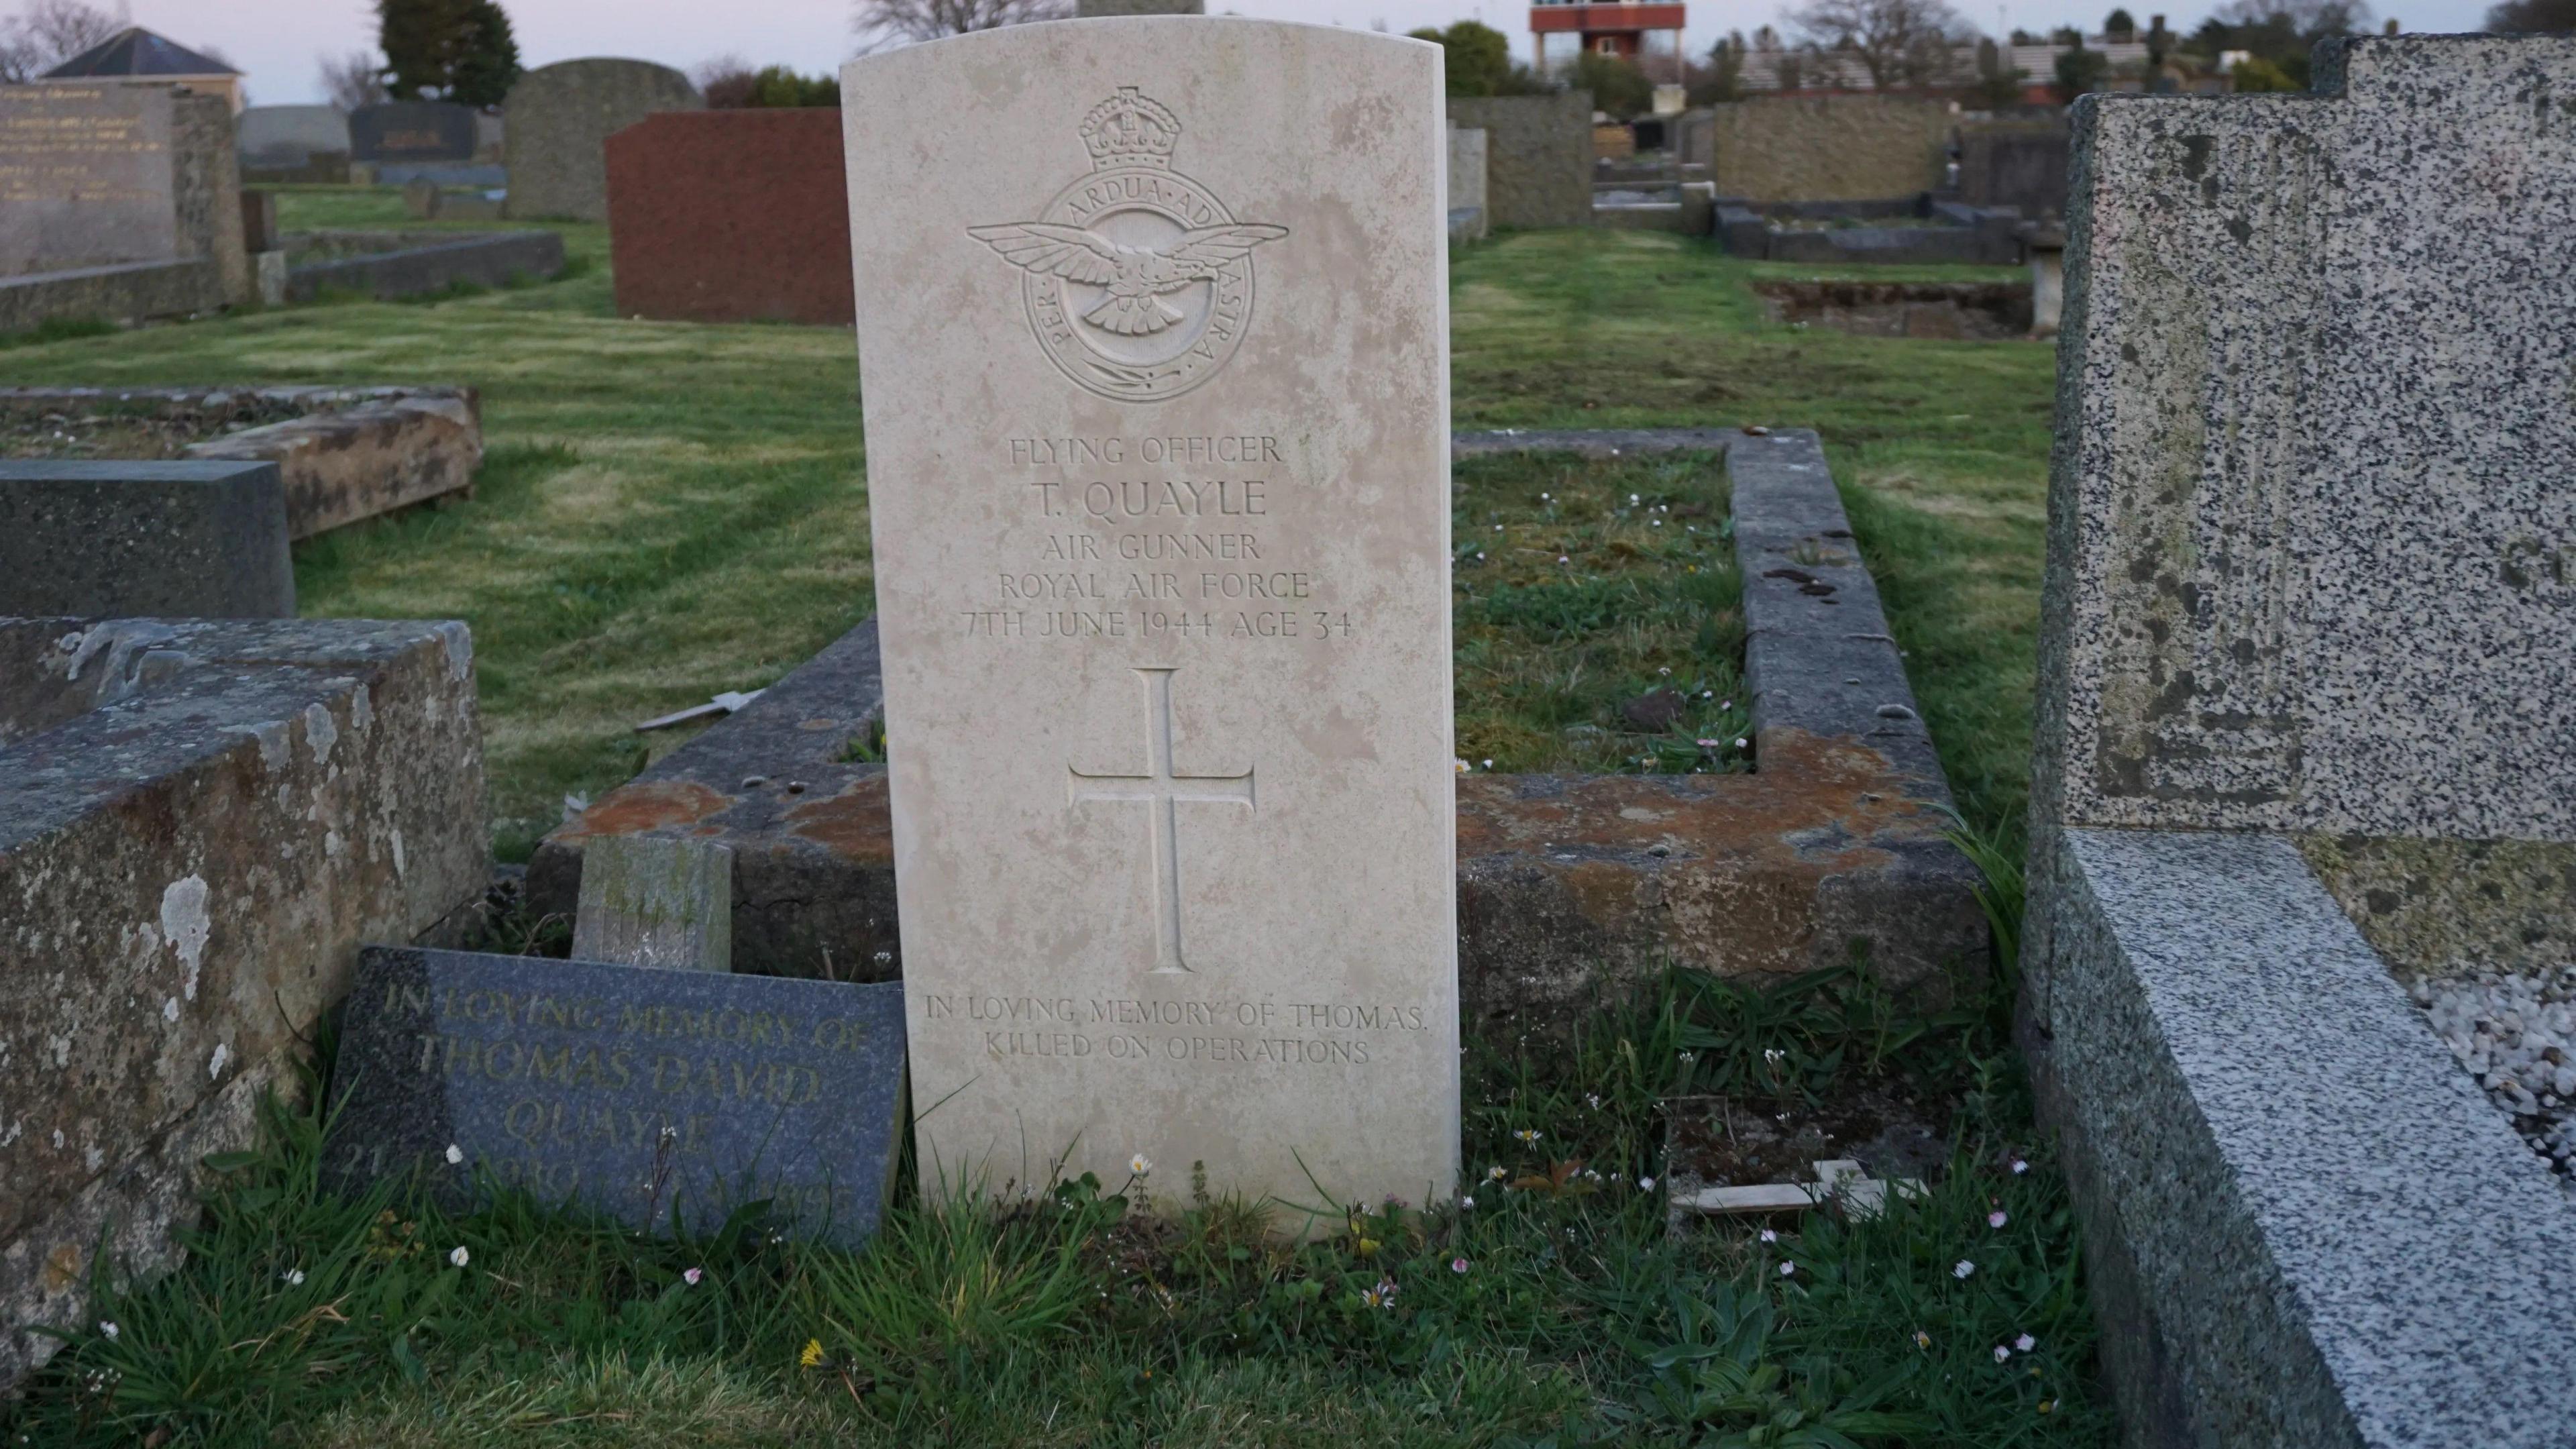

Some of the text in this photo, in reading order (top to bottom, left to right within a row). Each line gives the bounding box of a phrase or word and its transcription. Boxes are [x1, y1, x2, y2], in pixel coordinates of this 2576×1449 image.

[1037, 177, 1242, 361] PER ARDUA AD ASTRA
[1010, 436, 1283, 464] FLYING OFFICER
[1030, 480, 1267, 525] T. QUAYLE
[1042, 533, 1261, 561] AIR GUNNER
[999, 572, 1309, 599] ROYAL AIR FORCE
[961, 611, 1352, 641] 7TH JUNE 1944 AGE 34
[384, 979, 872, 1053] IN LOVING MEMORY OF
[925, 996, 1428, 1031] IN LOVING MEMORY OF THOMAS.
[985, 1032, 1370, 1065] KILLED ON OPERATIONS
[417, 1035, 821, 1104] THOMAS DAVID
